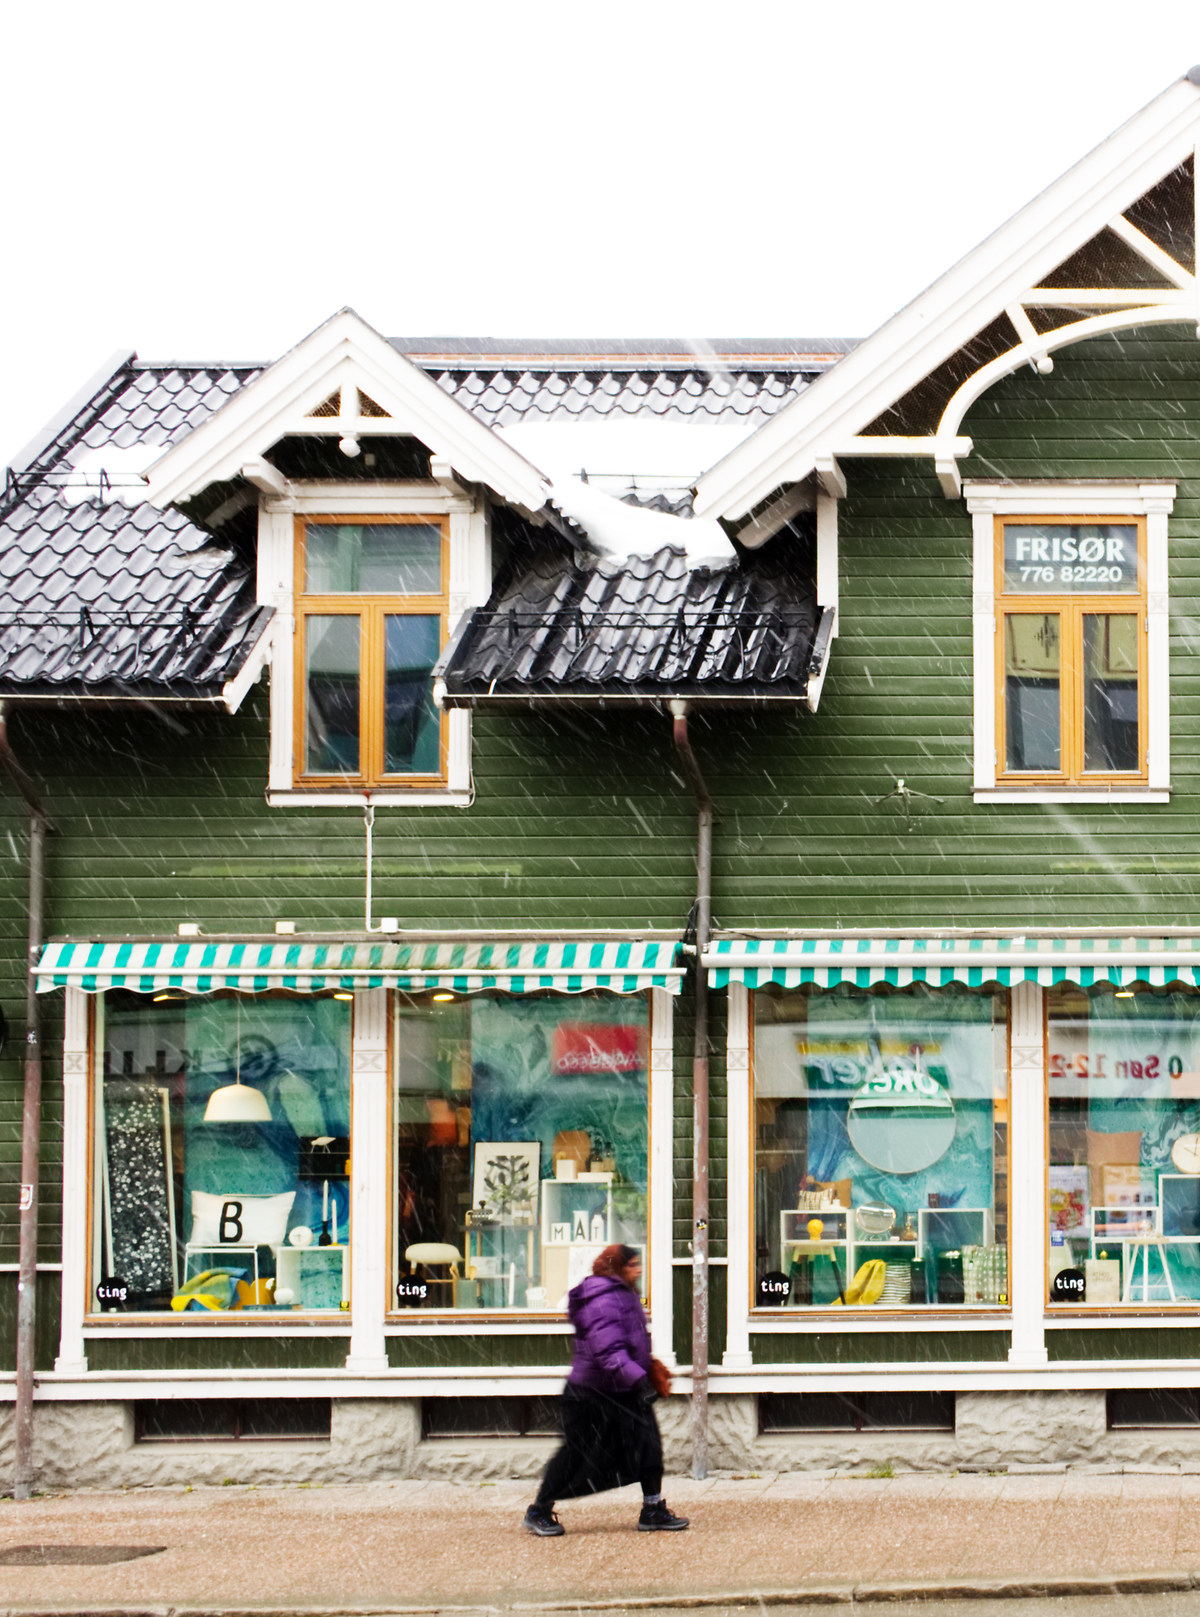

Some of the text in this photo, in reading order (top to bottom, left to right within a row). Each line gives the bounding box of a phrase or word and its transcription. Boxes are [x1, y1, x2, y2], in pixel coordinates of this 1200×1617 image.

[1015, 537, 1126, 562] FRISØR
[1019, 565, 1122, 582] 776 82220
[219, 1201, 243, 1243] B
[398, 1283, 427, 1298] ting
[761, 1280, 790, 1295] ting
[1056, 1277, 1084, 1291] ting
[97, 1285, 127, 1300] ting
